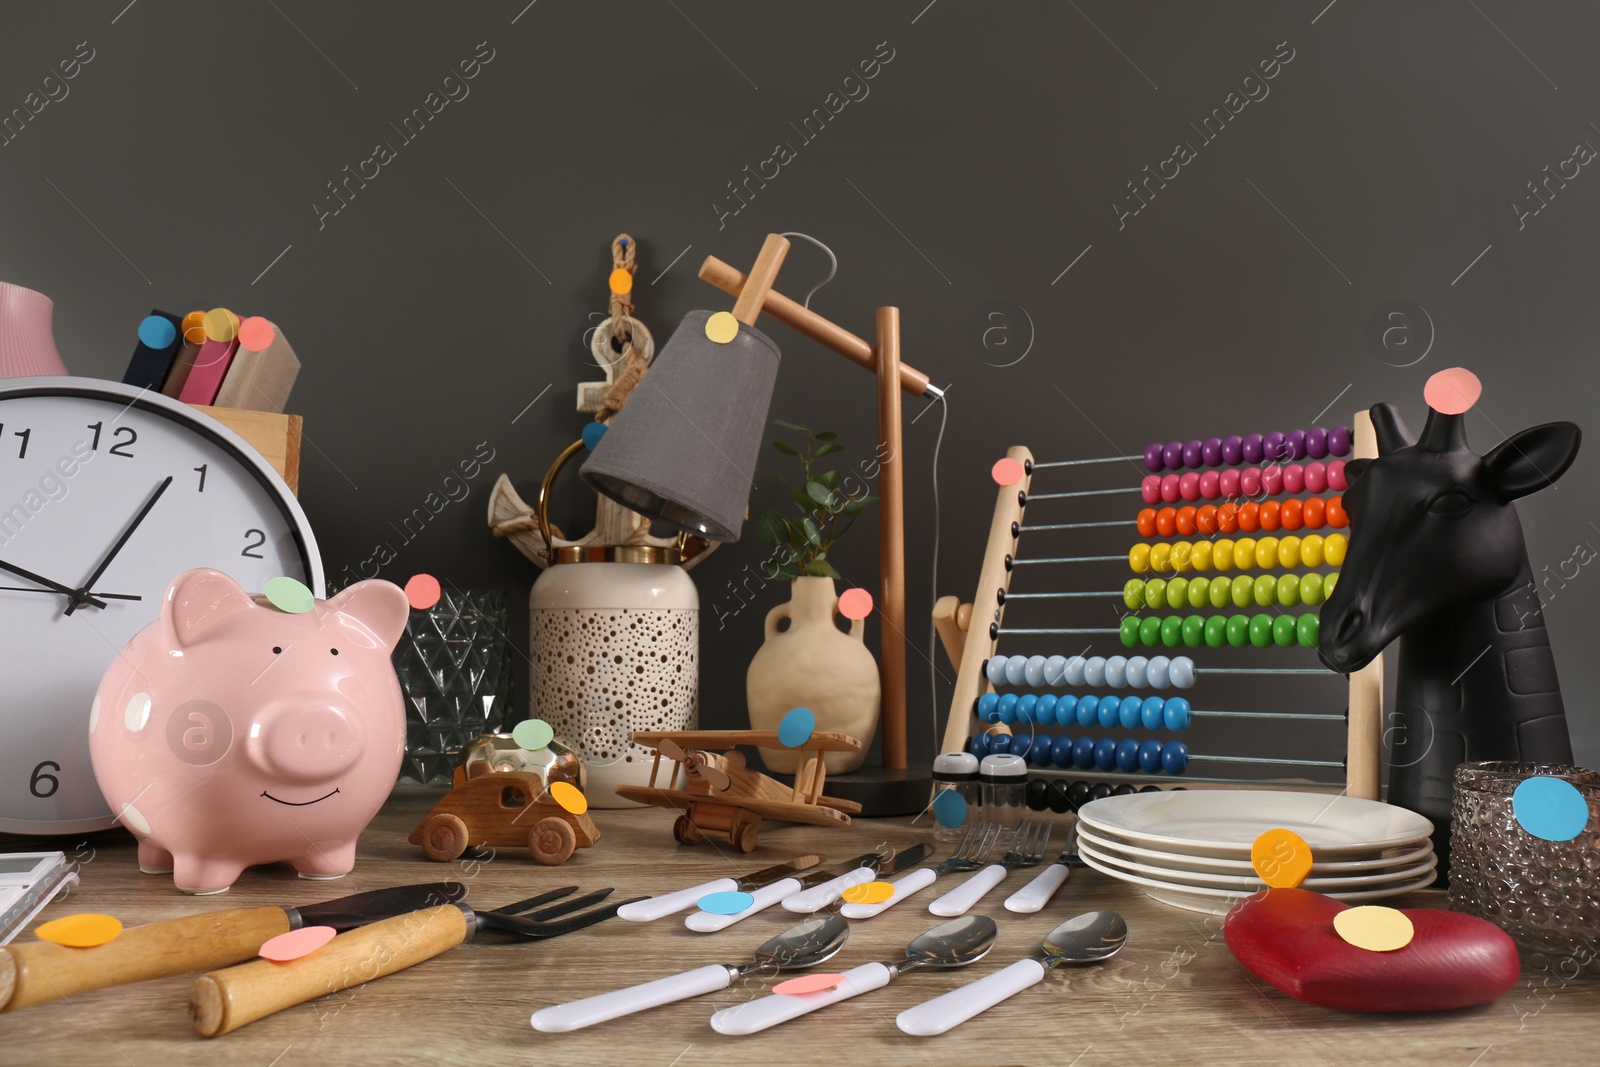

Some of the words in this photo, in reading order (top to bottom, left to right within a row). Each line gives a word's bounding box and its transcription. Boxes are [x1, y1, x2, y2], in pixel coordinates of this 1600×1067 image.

[0, 423, 30, 459] 1
[88, 422, 137, 458] 12
[194, 464, 207, 492] 1
[242, 529, 265, 558] 2
[30, 761, 60, 798] 6
